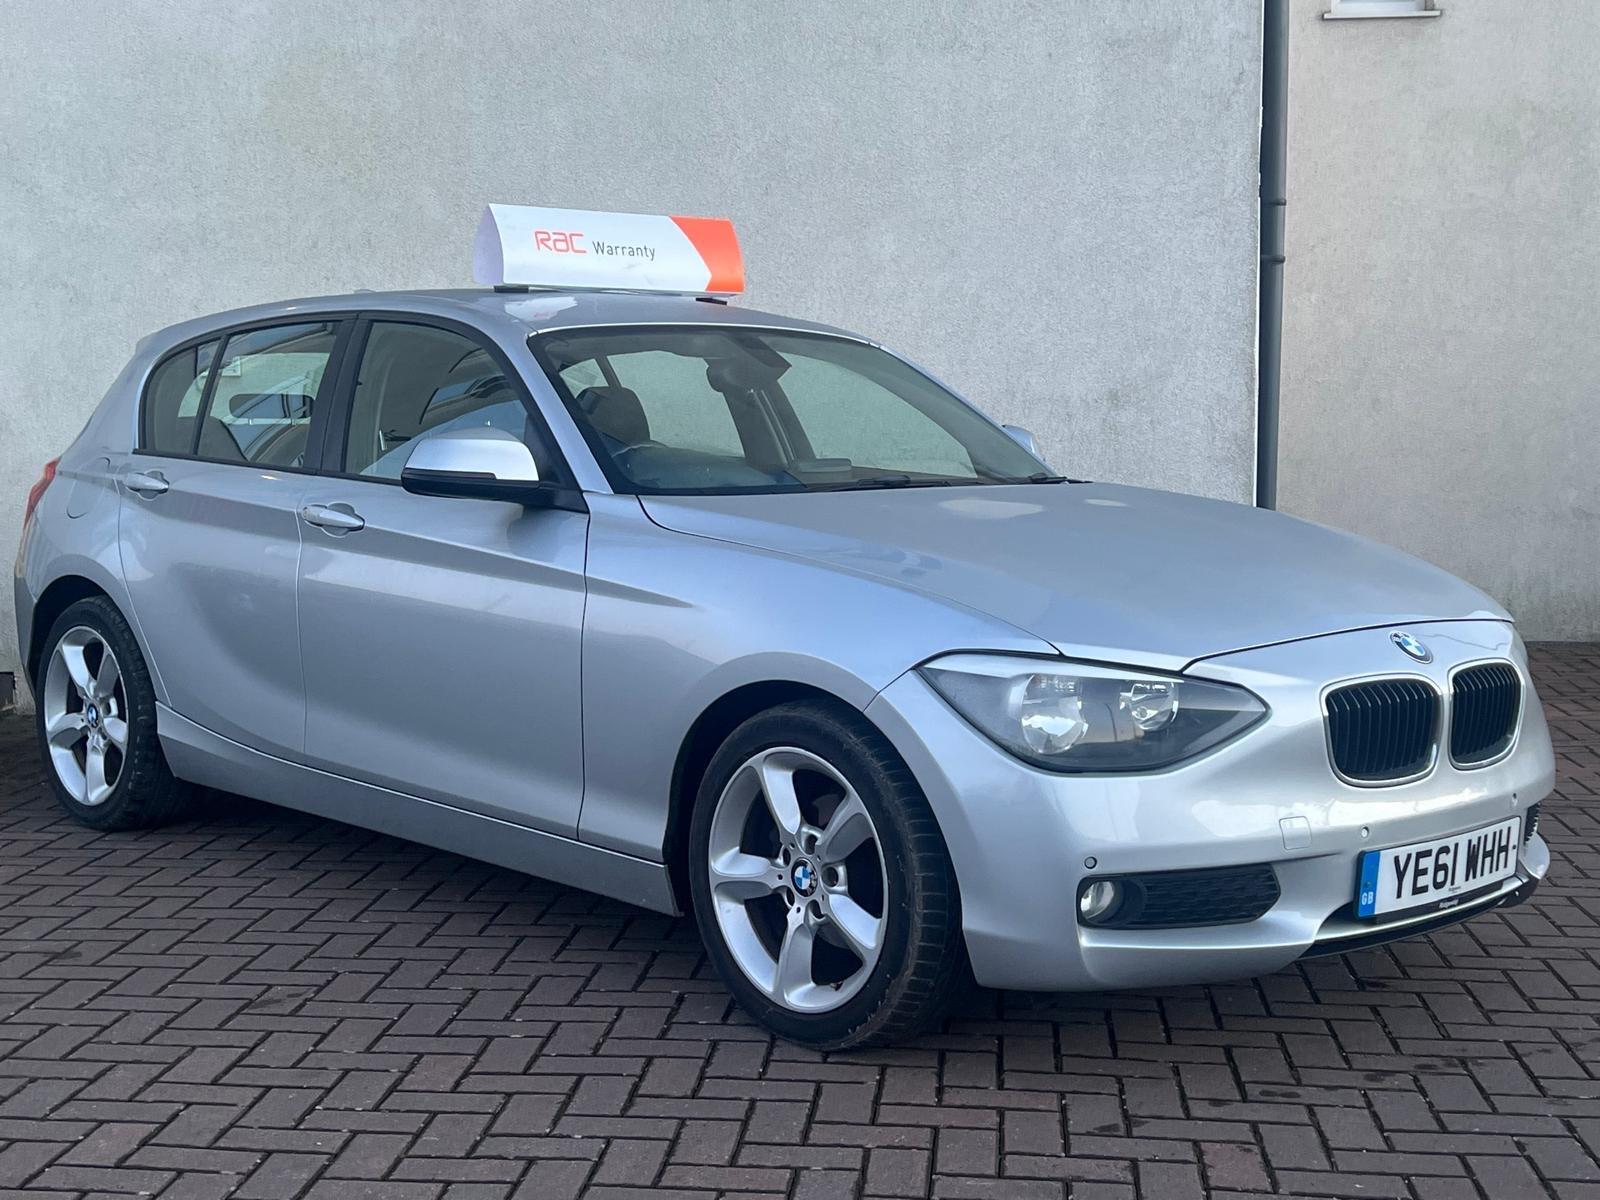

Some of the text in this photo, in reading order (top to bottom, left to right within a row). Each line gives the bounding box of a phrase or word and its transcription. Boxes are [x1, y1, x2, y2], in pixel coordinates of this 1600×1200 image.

[592, 241, 655, 261] Warranty
[1394, 826, 1511, 899] YE61 WHH
[1361, 891, 1374, 906] GB
